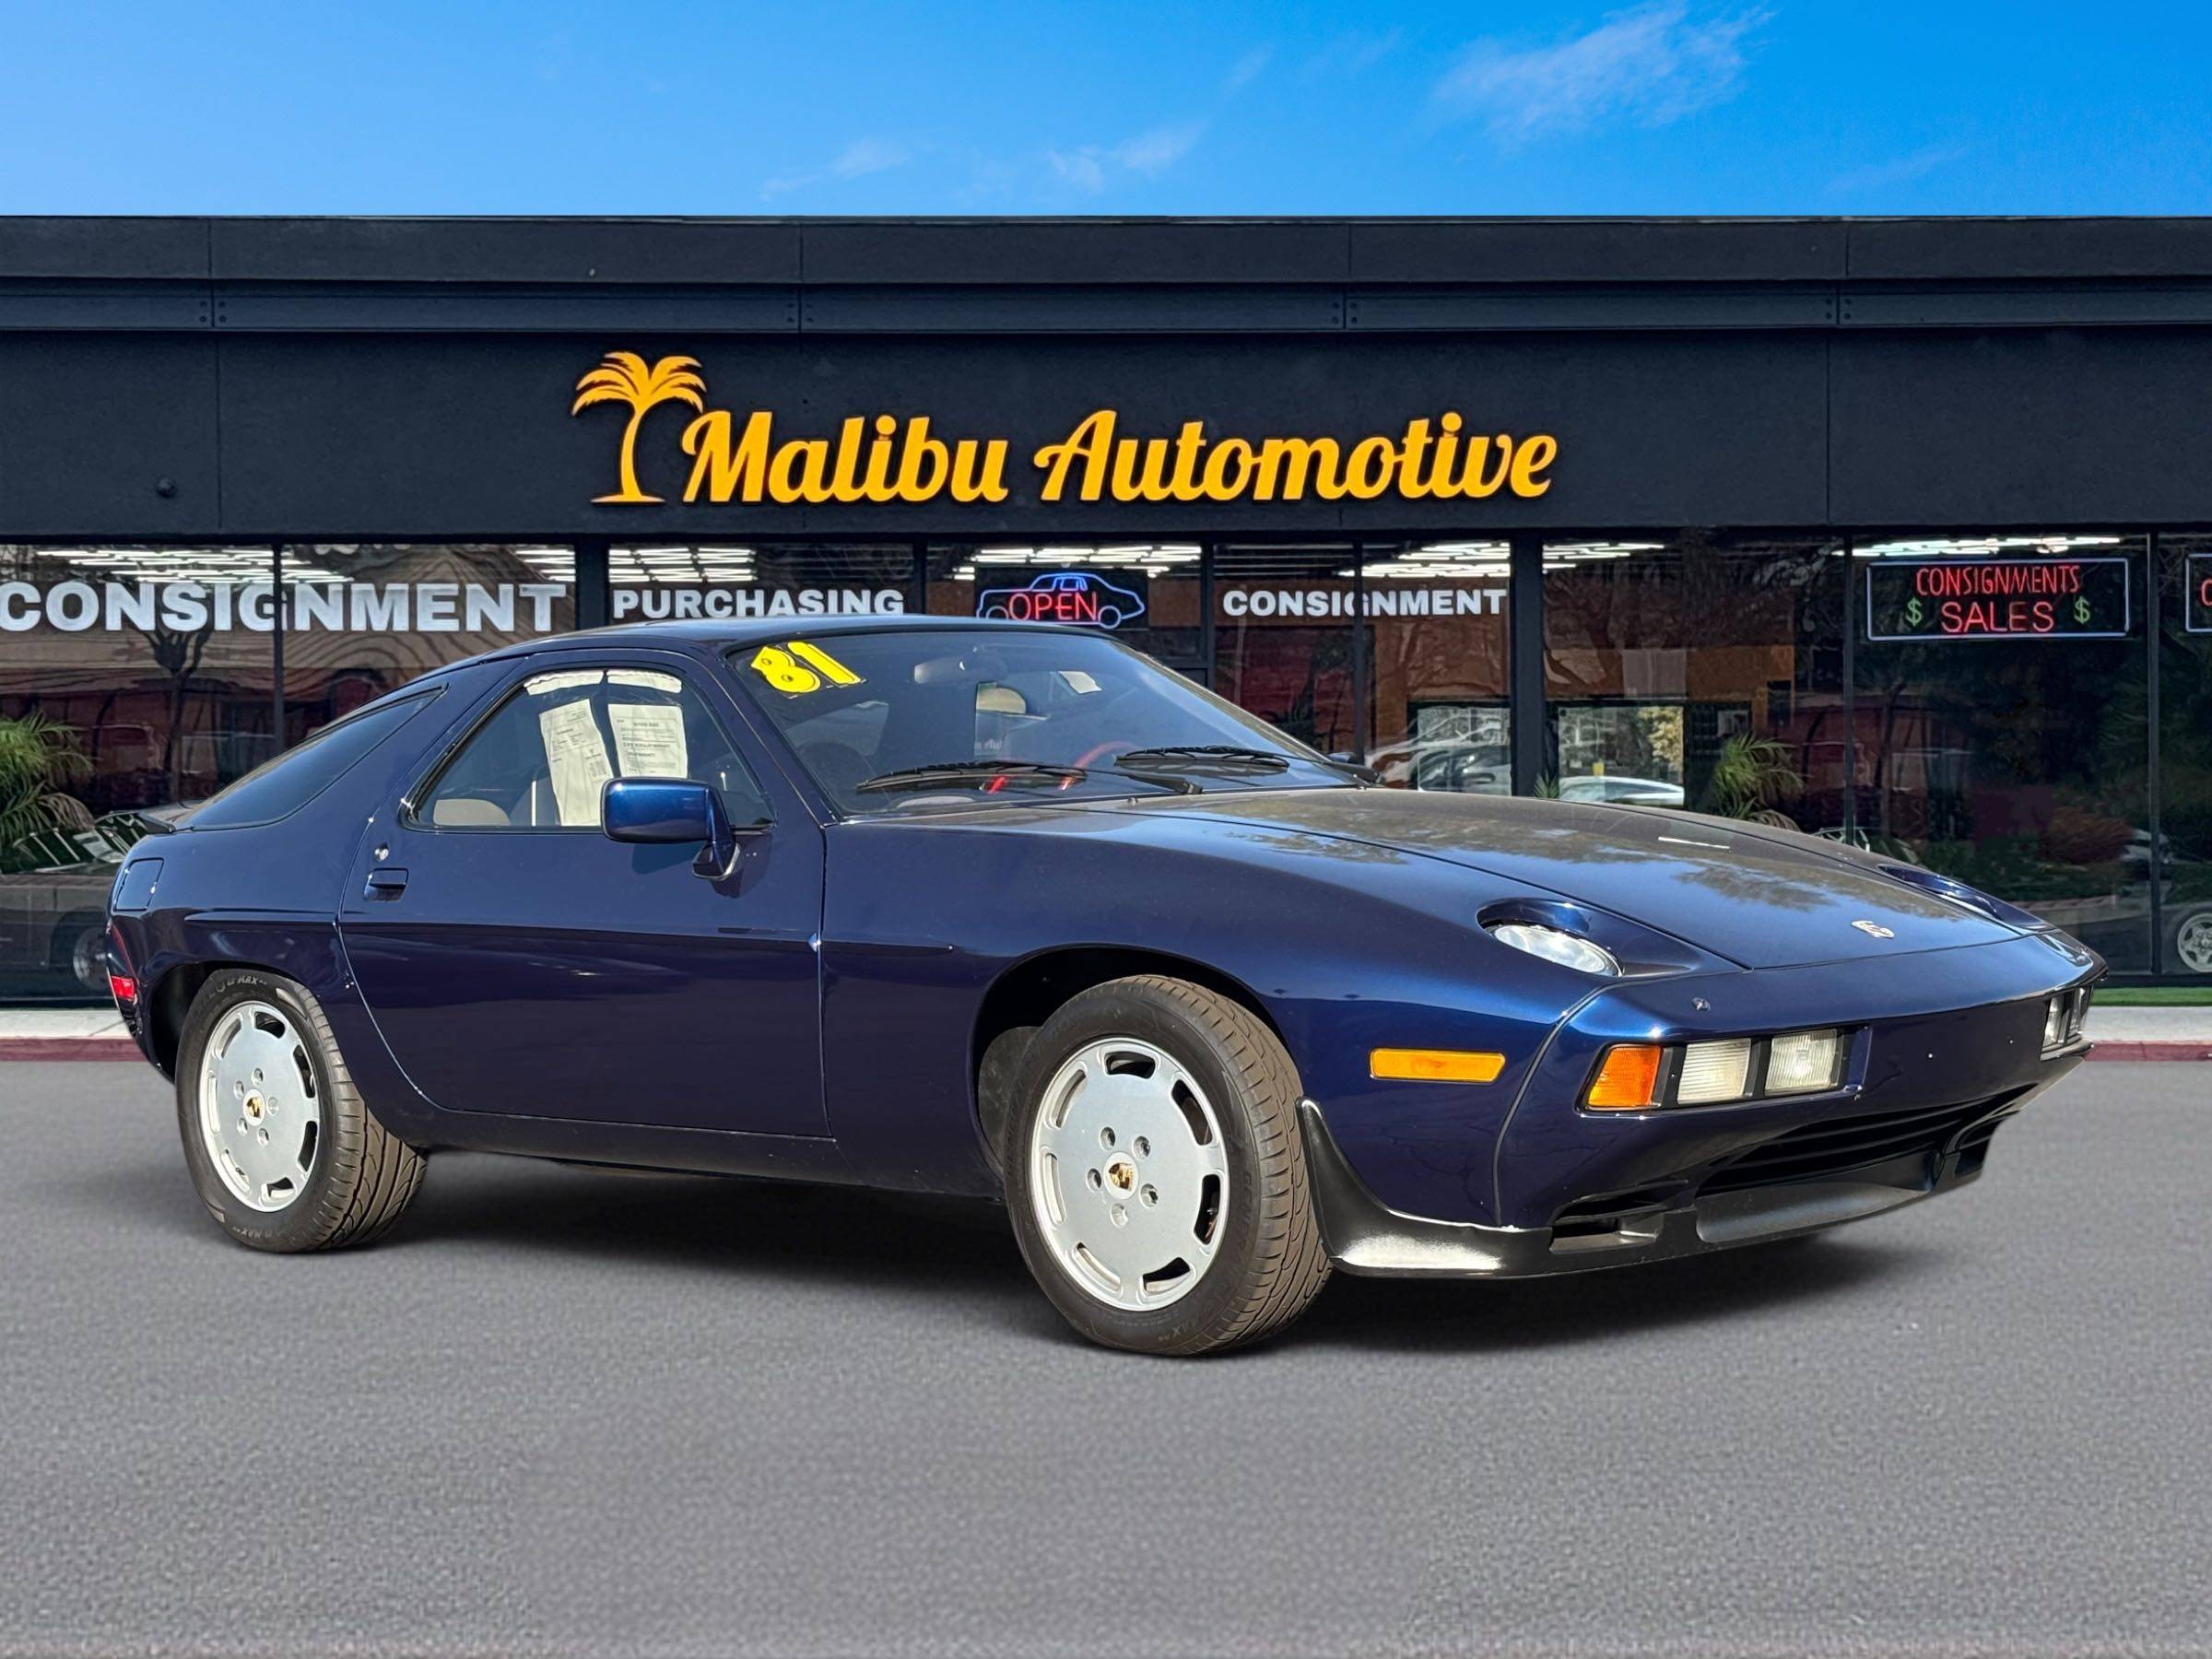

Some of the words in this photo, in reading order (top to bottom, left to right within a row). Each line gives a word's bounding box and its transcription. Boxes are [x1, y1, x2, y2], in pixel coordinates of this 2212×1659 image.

[681, 410, 1008, 503] Malibu
[1033, 409, 1558, 501] Automotive
[1916, 565, 2080, 595] CONSIGNMENTS
[0, 581, 566, 631] CONSIGNMENT
[613, 589, 904, 618] PURCHASING
[1008, 592, 1097, 621] OPEN
[1940, 601, 2054, 632] SALES
[750, 641, 862, 693] 81
